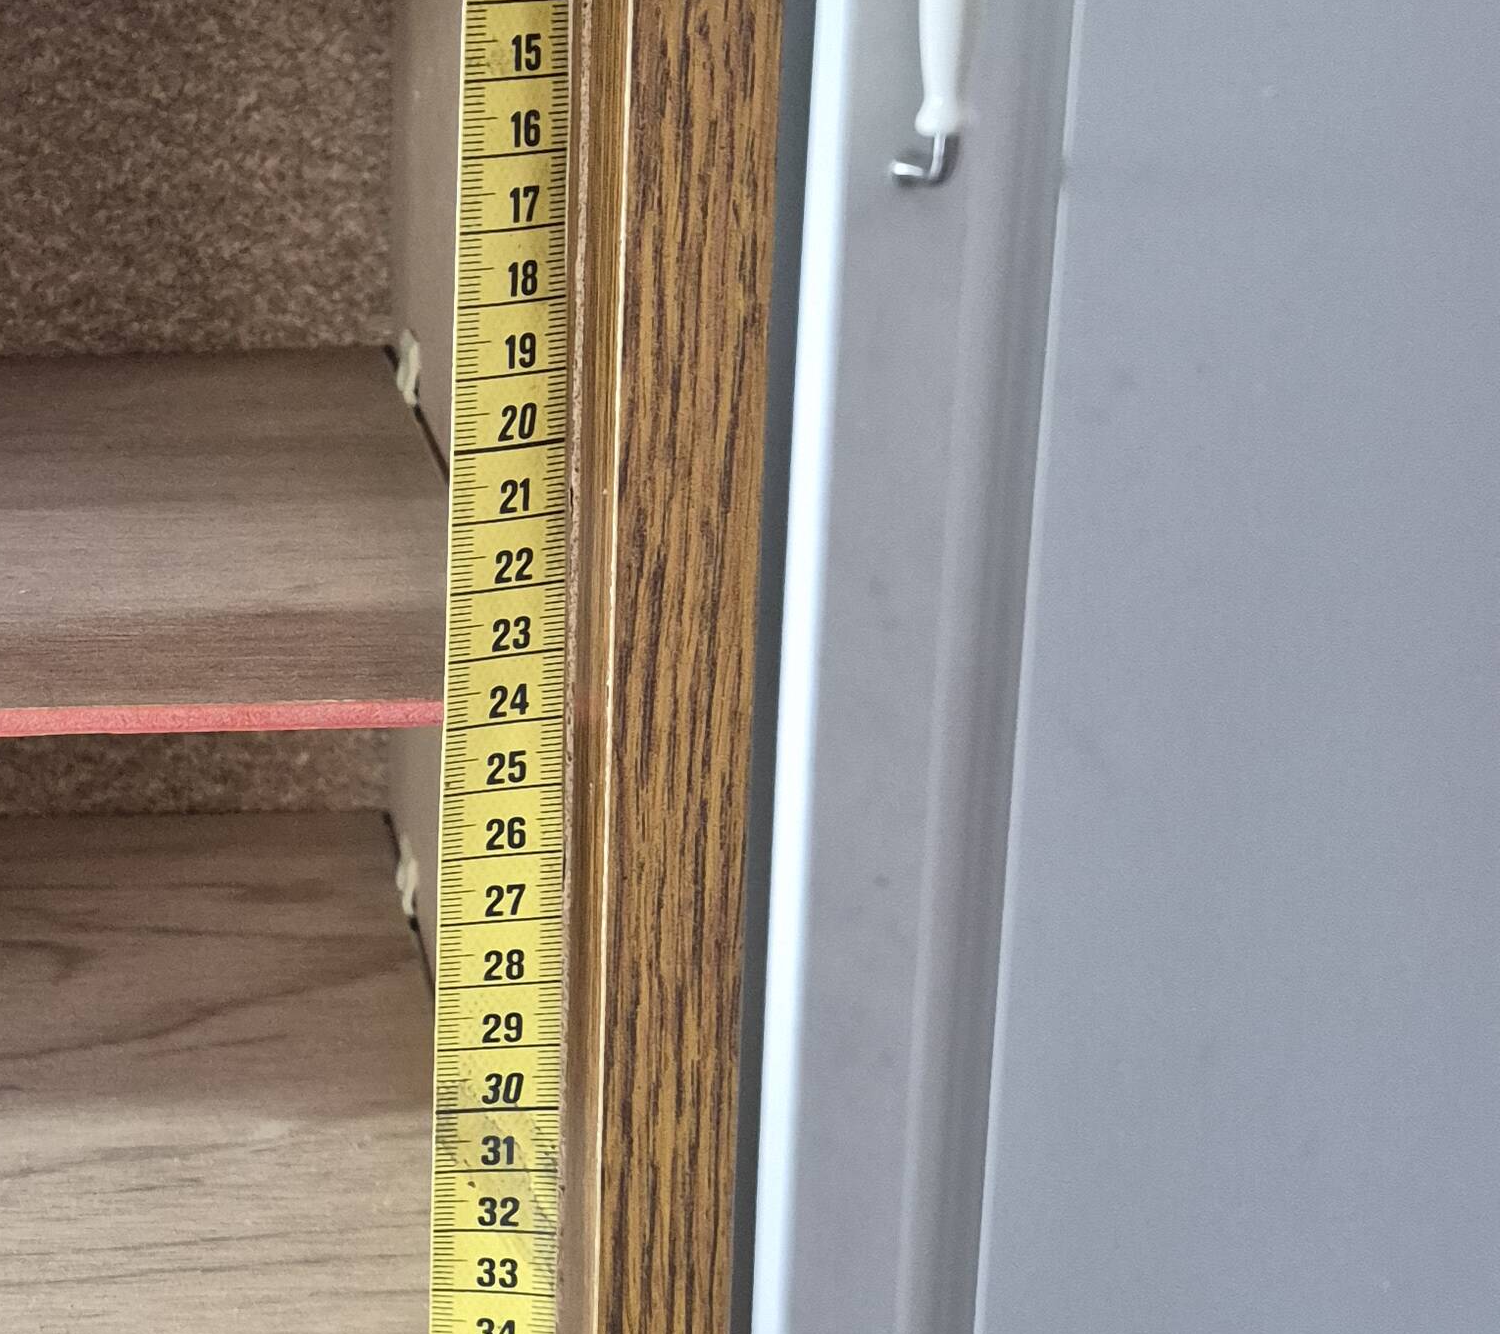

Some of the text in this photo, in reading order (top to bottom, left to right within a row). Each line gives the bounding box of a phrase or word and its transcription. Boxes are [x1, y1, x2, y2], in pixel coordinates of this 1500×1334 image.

[512, 33, 542, 72] 15
[511, 109, 541, 147] 16
[509, 185, 540, 223] 17
[508, 260, 538, 297] 18
[505, 332, 537, 370] 19
[497, 402, 538, 442] 20
[499, 478, 530, 514] 21
[494, 547, 534, 584] 22
[492, 616, 531, 652] 23
[488, 683, 529, 718] 24
[486, 750, 527, 785] 25
[486, 817, 526, 850] 26
[485, 884, 526, 917] 27
[483, 949, 524, 981] 28
[482, 1012, 523, 1043] 29
[482, 1072, 524, 1105] 30
[481, 1135, 515, 1166] 31
[478, 1196, 520, 1227] 32
[476, 1258, 518, 1289] 33
